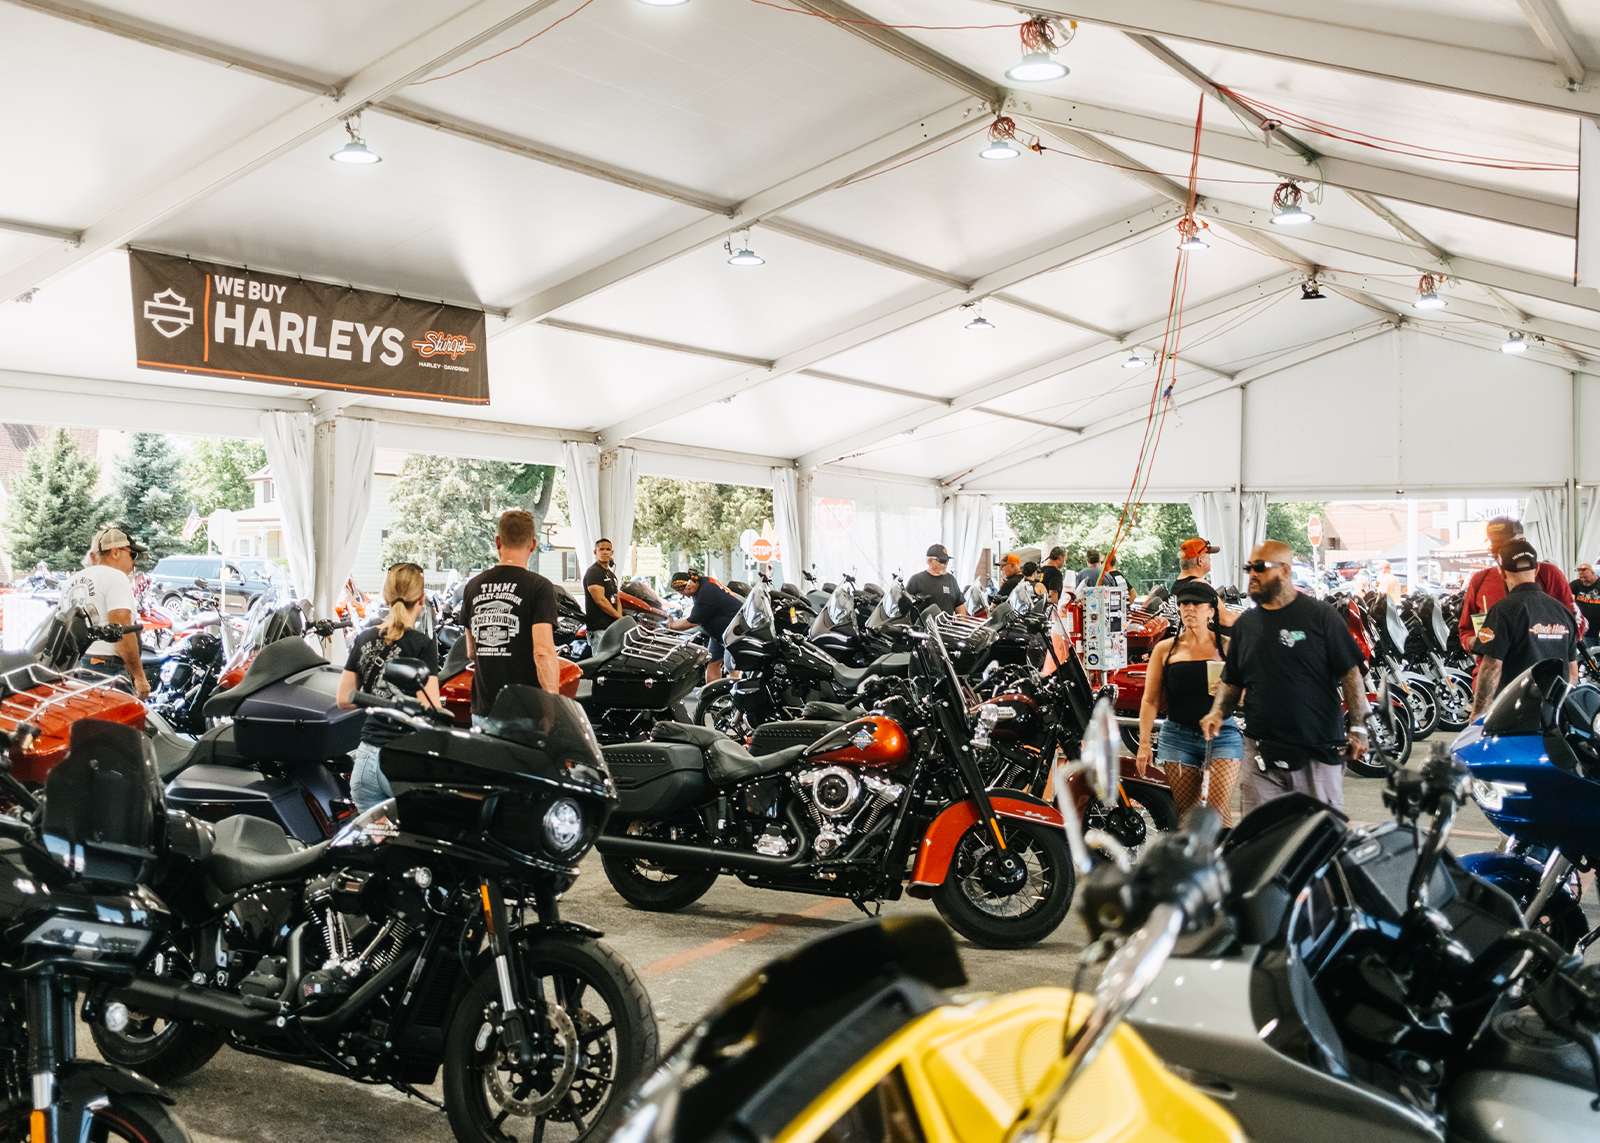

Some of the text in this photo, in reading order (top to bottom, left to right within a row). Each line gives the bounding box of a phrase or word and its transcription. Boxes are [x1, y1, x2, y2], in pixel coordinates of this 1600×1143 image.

[214, 275, 287, 304] WE BUY
[214, 301, 405, 367] HARLEYS
[413, 332, 475, 359] Sturgis
[418, 361, 470, 373] HARLEY-DAVIDSON
[818, 503, 853, 520] STOP
[1308, 525, 1322, 537] STOP
[752, 545, 772, 556] STOP
[480, 582, 518, 593] TIMMS
[472, 591, 523, 606] HARLEY-DAVIDSON
